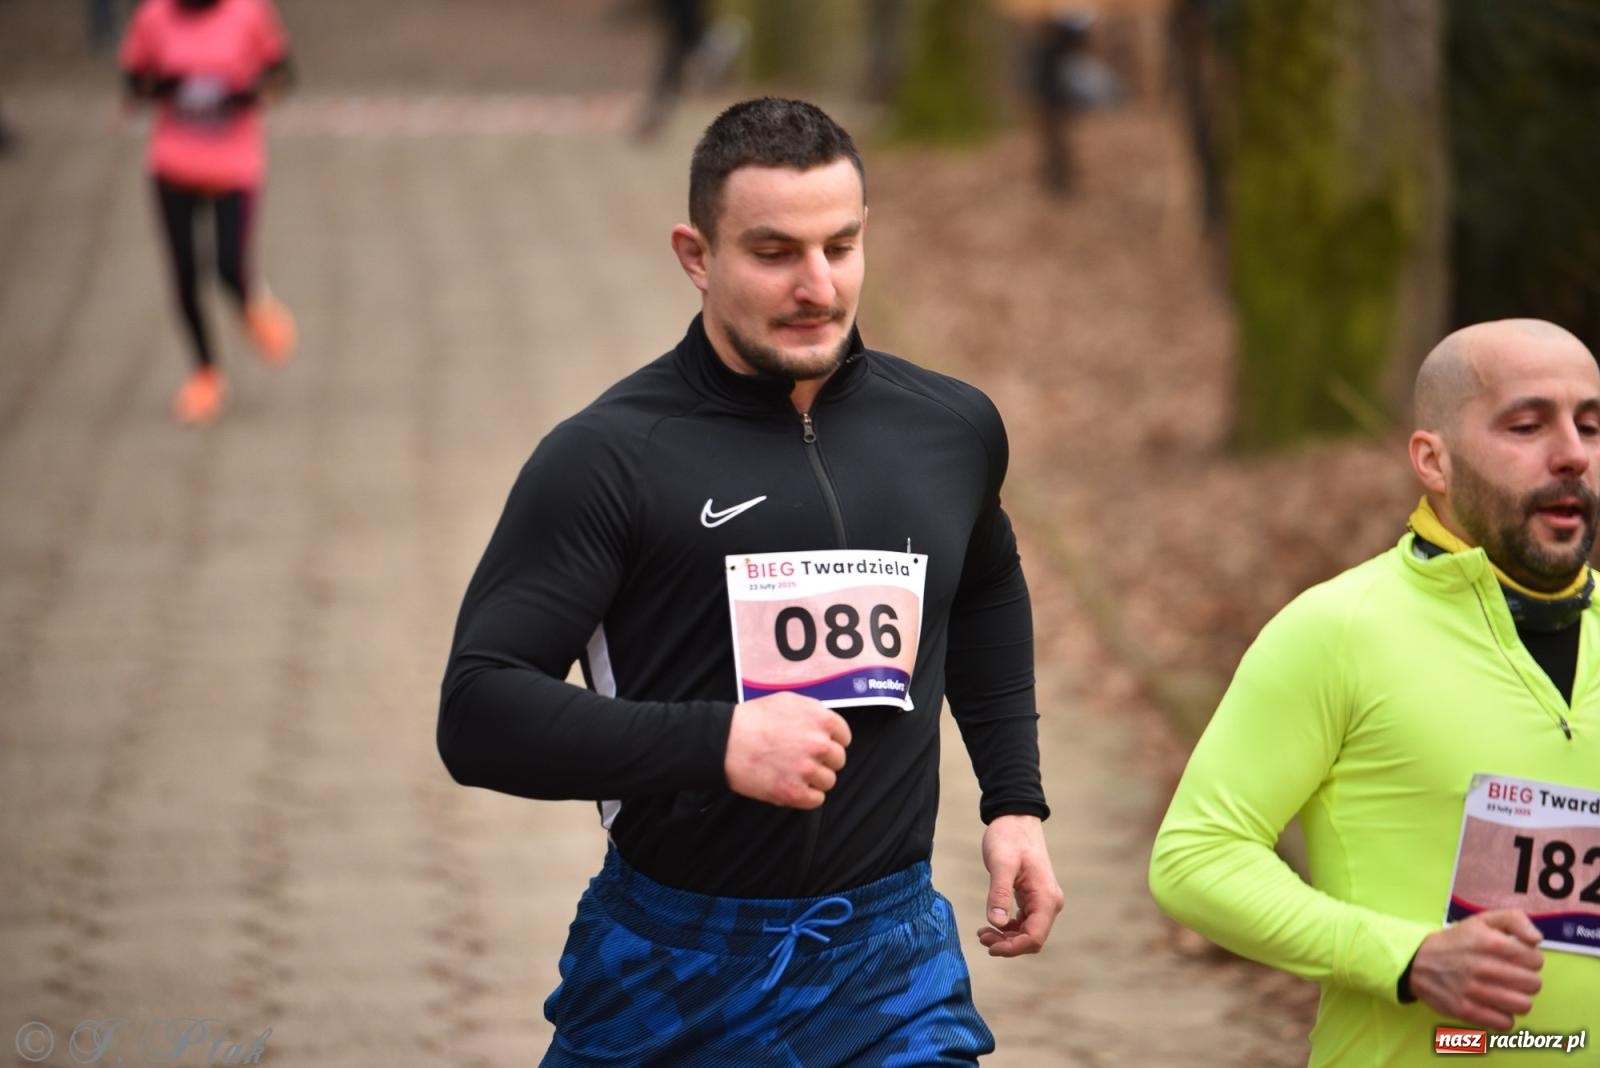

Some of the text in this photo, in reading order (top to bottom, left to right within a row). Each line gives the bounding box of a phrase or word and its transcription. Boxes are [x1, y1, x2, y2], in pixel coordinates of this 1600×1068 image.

[747, 558, 910, 579] BIEG Twardziela
[775, 603, 902, 662] 086
[1488, 782, 1533, 804] BIEG
[1513, 834, 1600, 905] 182
